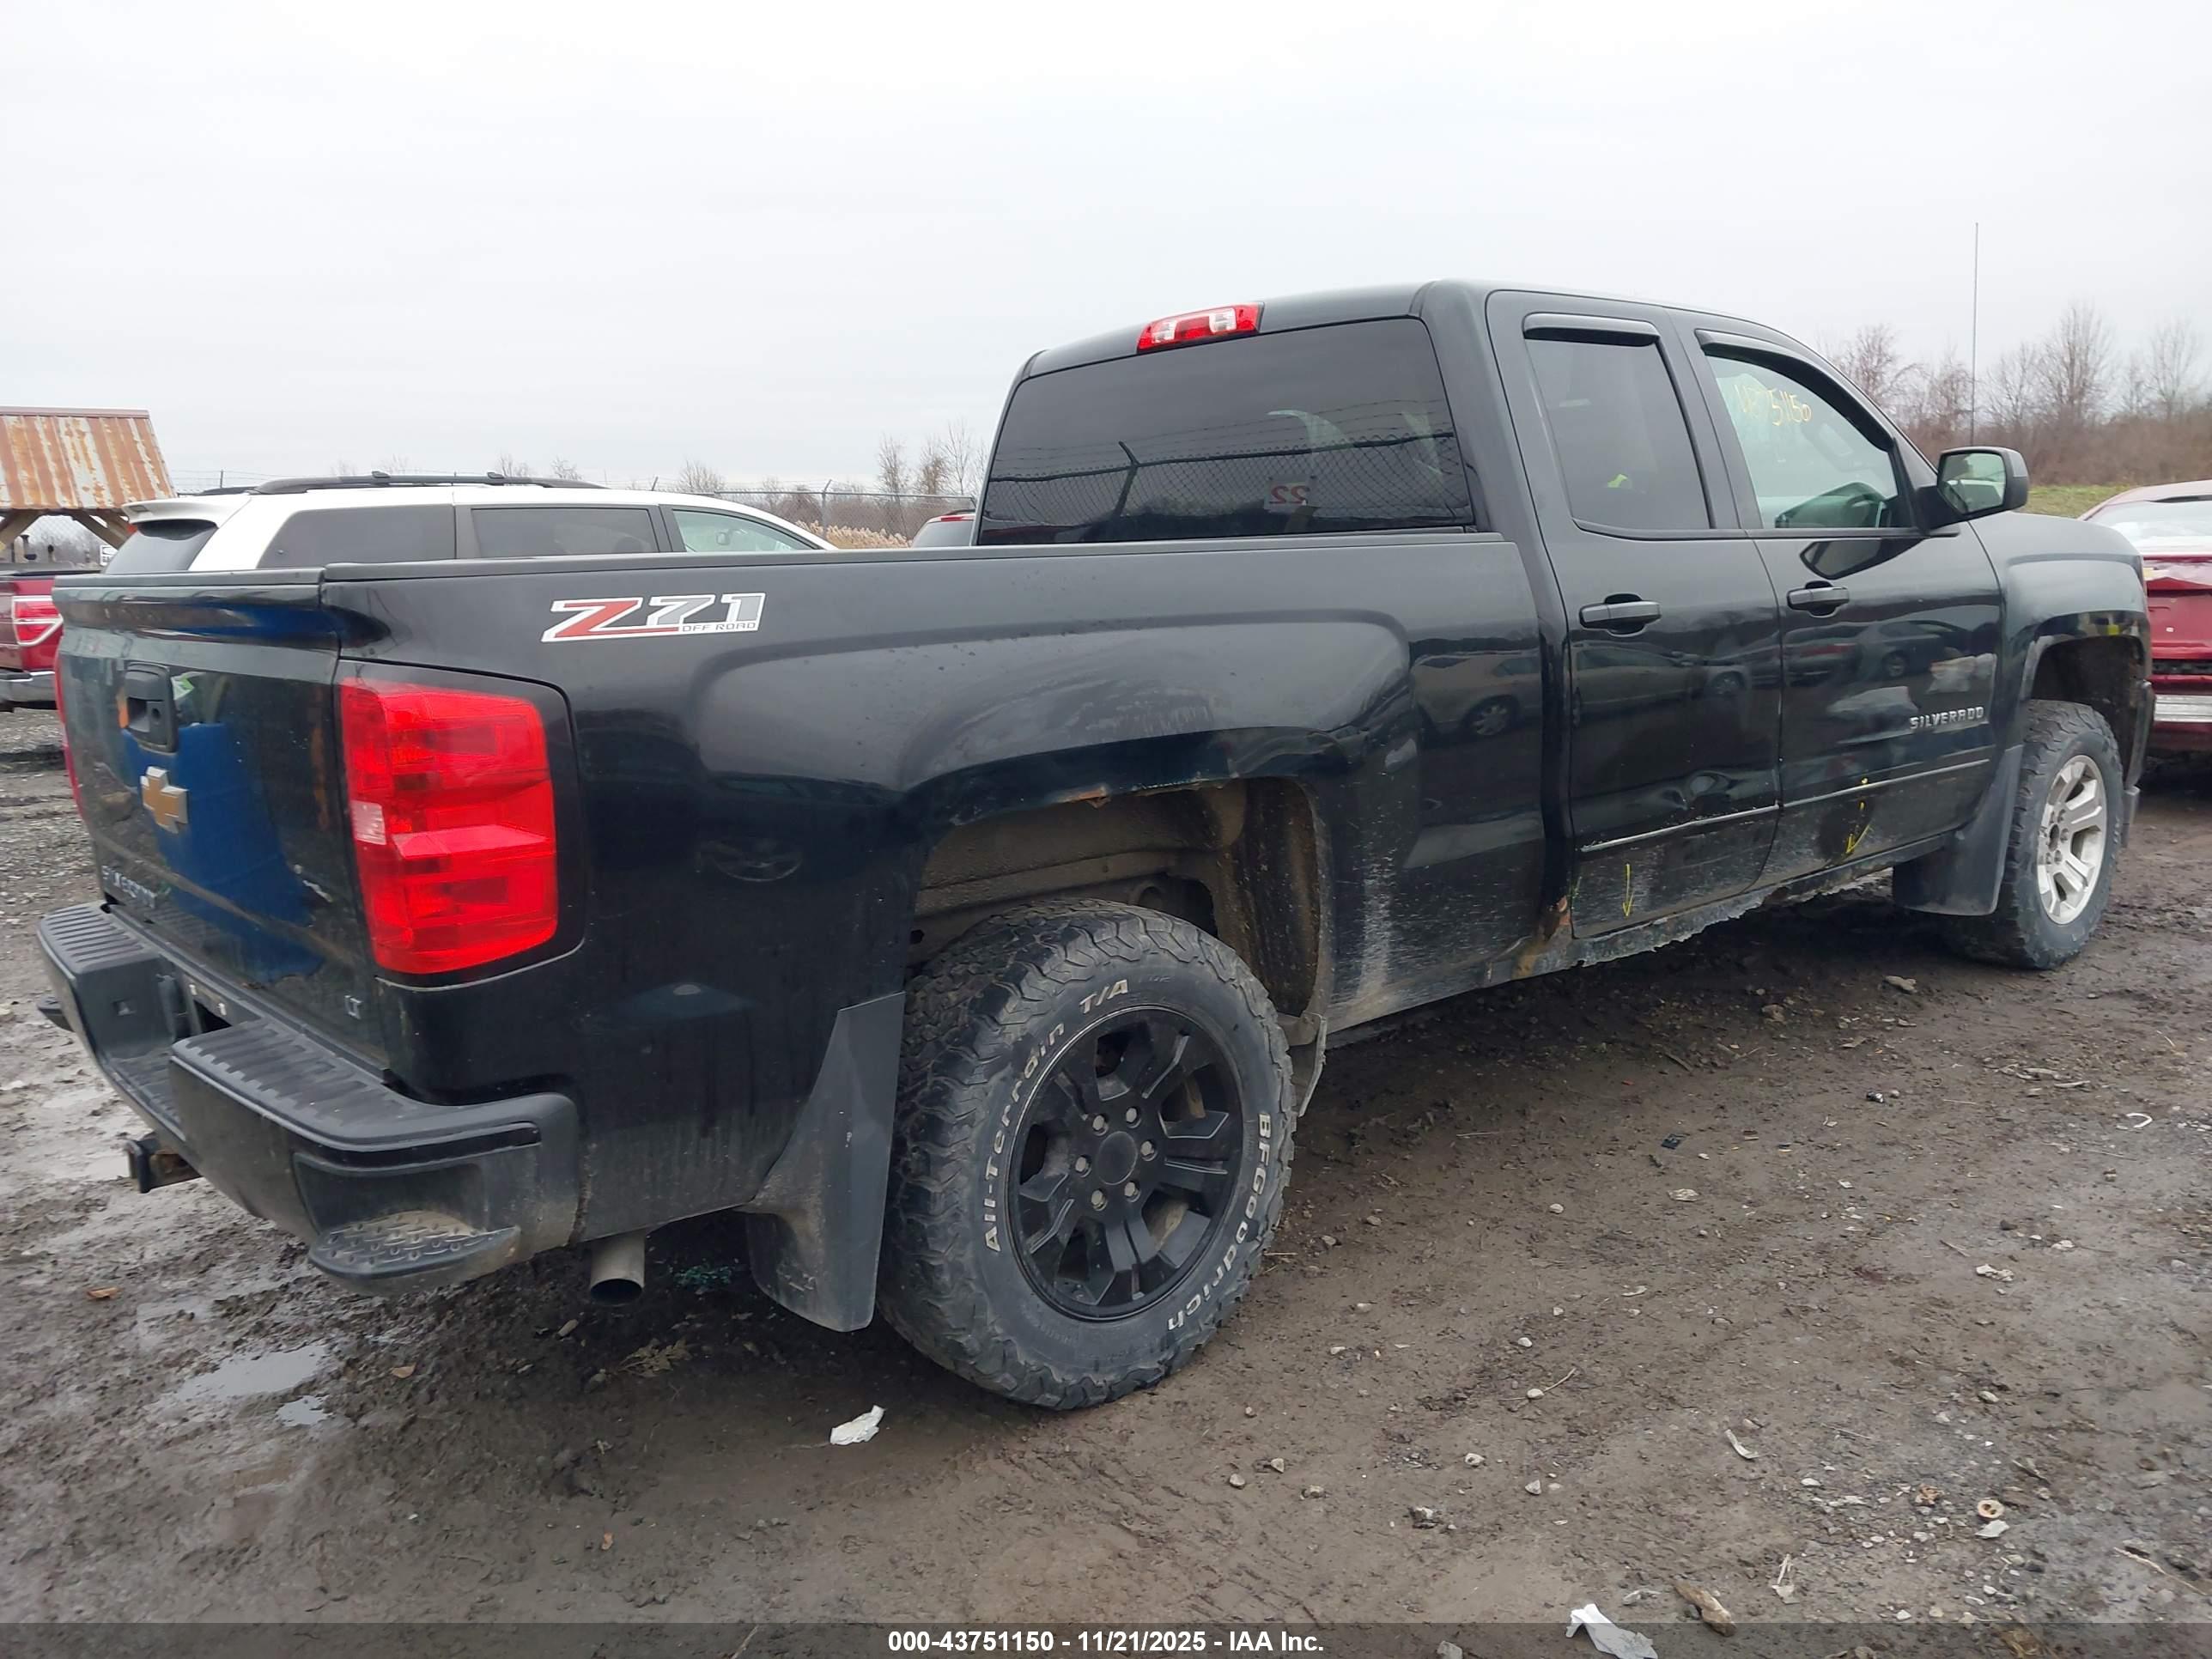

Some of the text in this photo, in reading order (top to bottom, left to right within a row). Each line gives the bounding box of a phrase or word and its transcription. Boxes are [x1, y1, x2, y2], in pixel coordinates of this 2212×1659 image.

[541, 592, 766, 642] Z71
[682, 621, 756, 633] OFF ROAD
[1909, 706, 1984, 730] SILVERADO
[1079, 979, 1129, 1014] T/A
[1167, 1112, 1273, 1331] BFGoodrich
